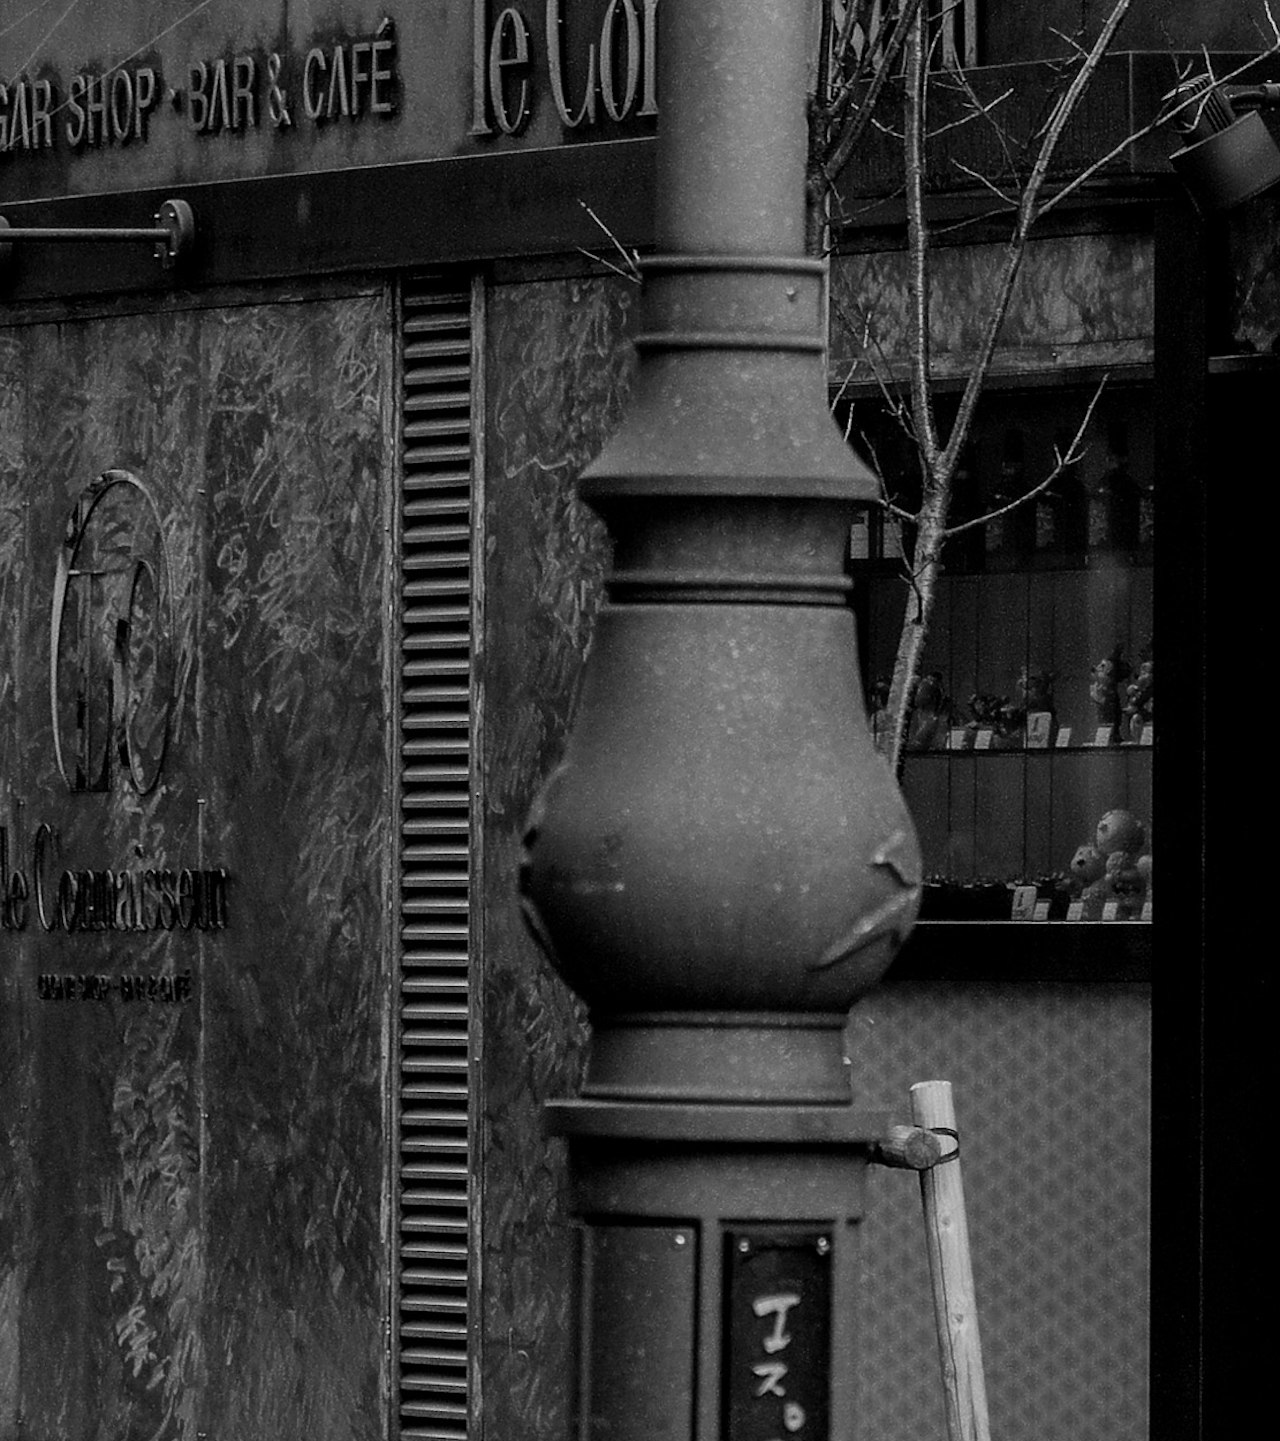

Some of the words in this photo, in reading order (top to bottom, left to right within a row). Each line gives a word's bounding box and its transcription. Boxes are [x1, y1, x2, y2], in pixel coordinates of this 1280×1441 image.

[65, 67, 157, 147] SHOP
[187, 55, 258, 134] BAR
[266, 52, 292, 128] &
[303, 17, 394, 121] CAFÉ
